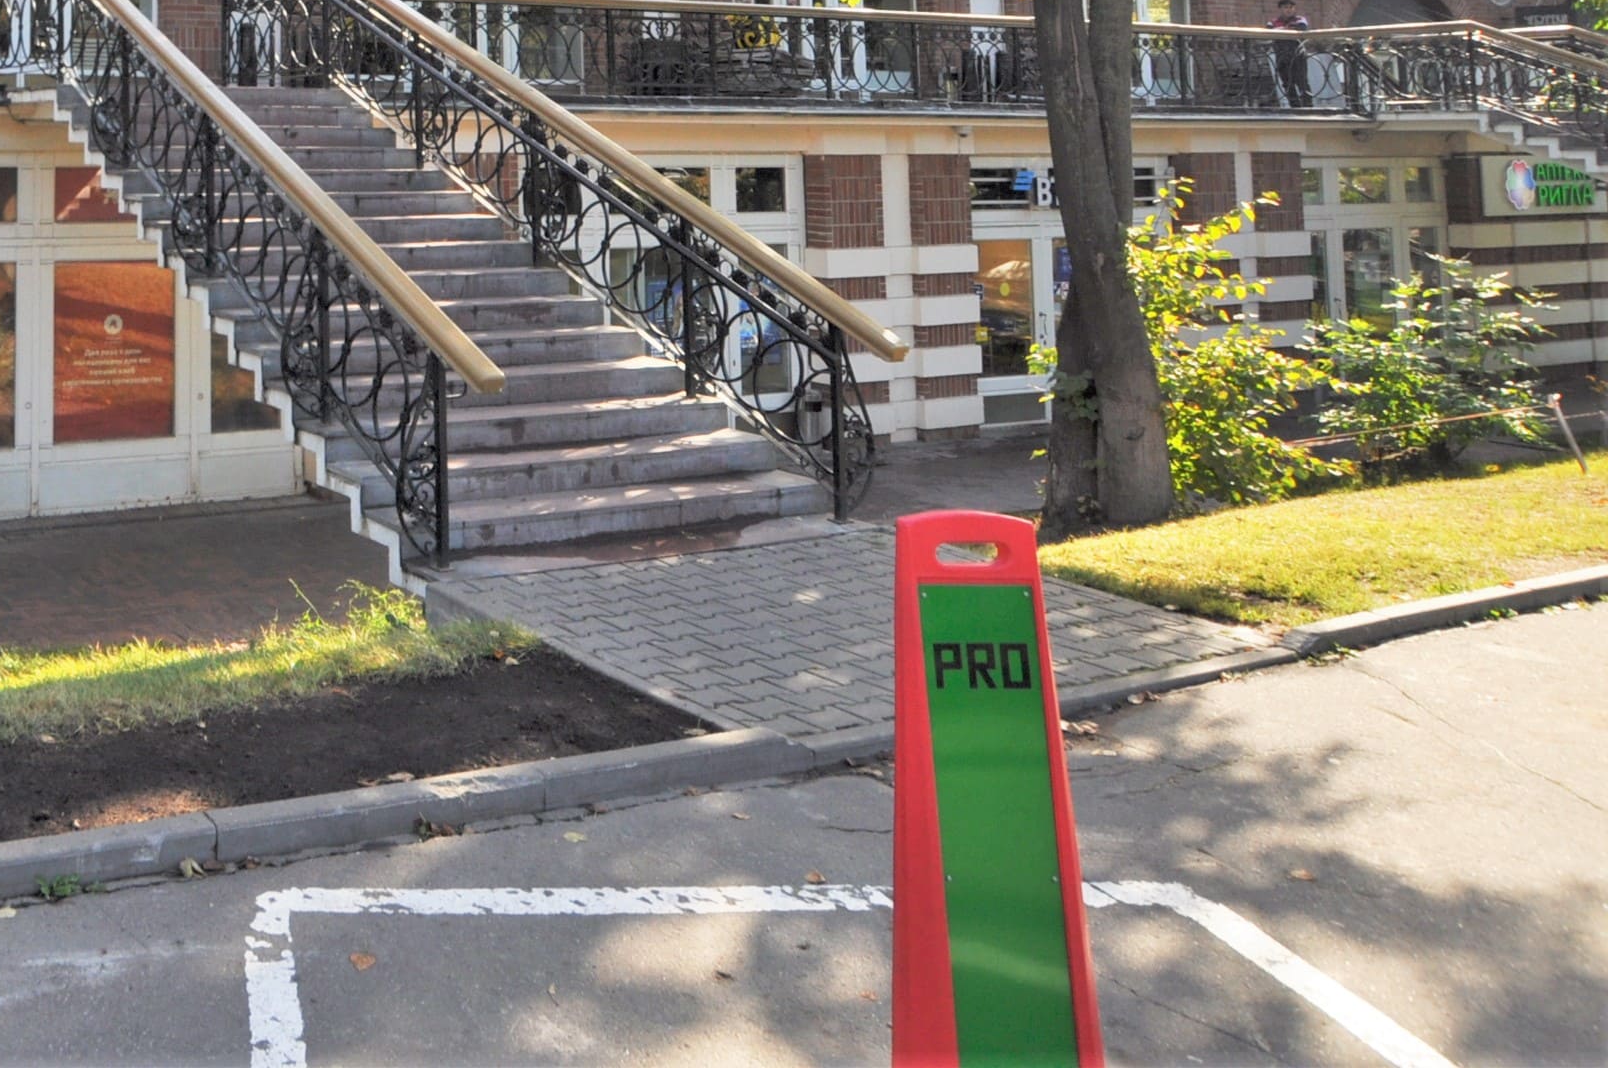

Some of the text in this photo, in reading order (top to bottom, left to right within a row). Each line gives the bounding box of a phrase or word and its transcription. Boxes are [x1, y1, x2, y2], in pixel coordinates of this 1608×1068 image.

[1535, 162, 1591, 182] АПТЕК
[1536, 184, 1595, 206] РИГЛА
[932, 642, 1032, 690] PRO
